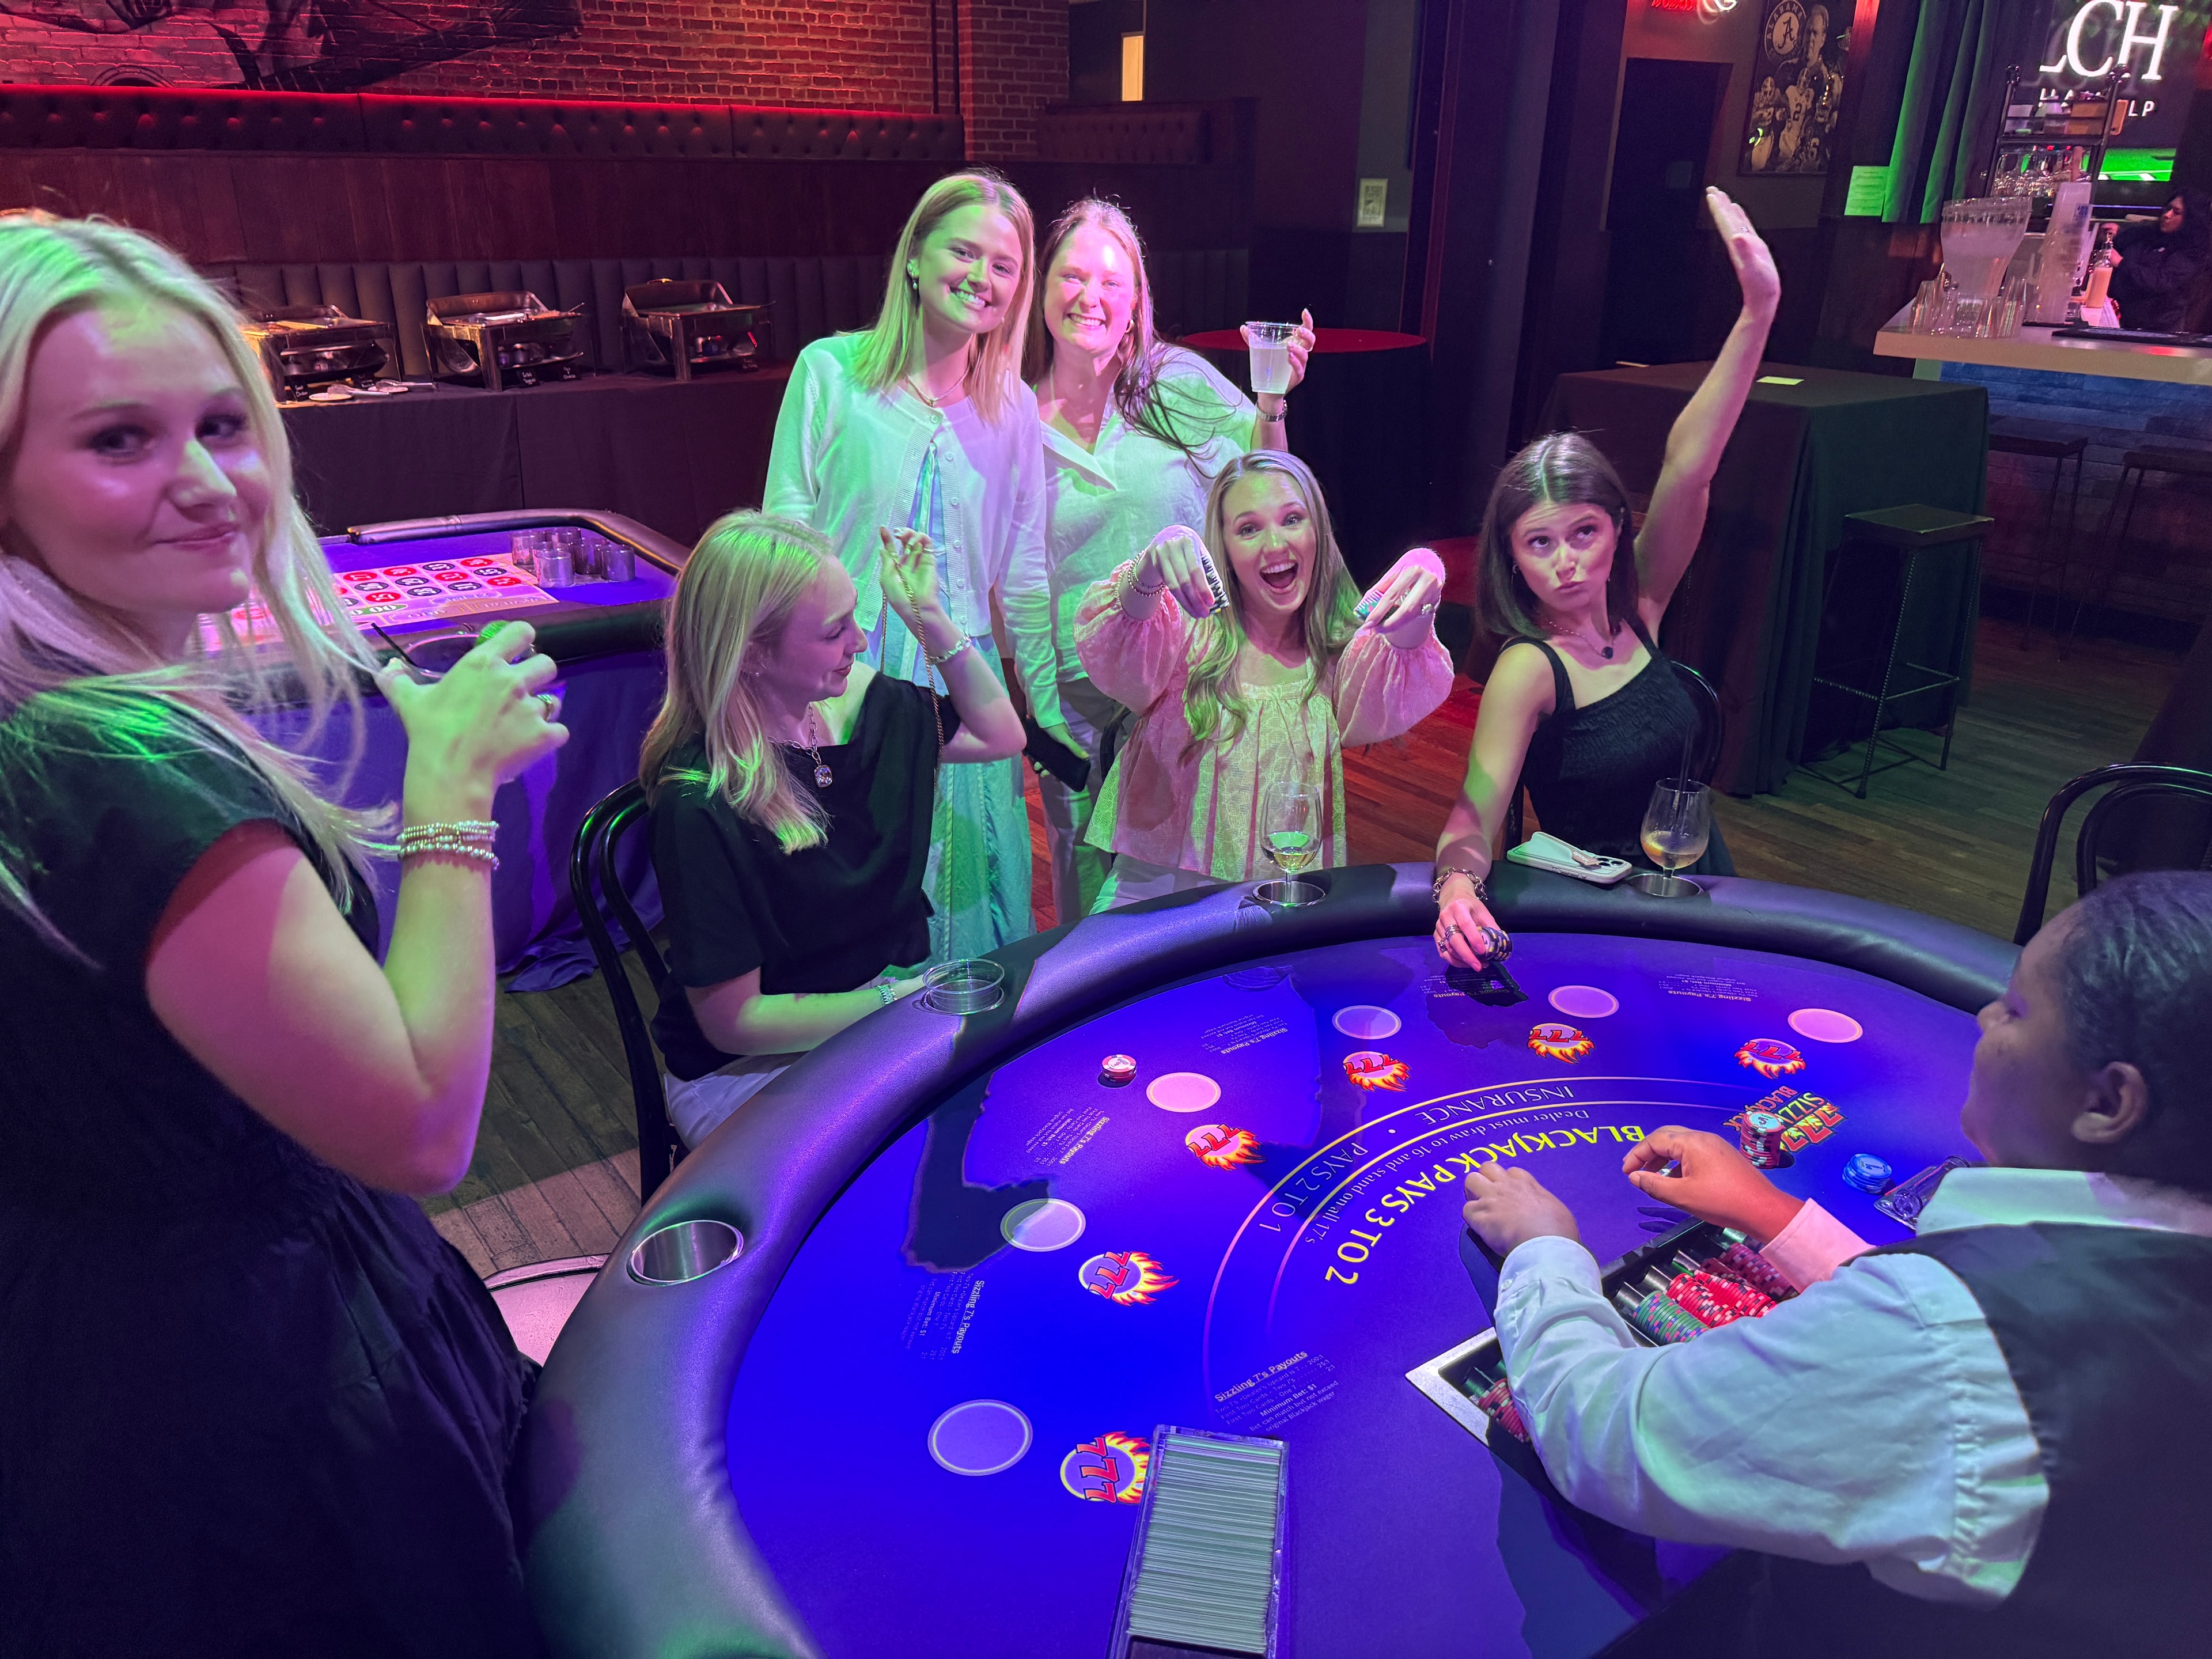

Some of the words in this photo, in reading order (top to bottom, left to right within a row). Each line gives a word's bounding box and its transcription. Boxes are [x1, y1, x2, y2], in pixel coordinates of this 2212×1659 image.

[1258, 1027, 1289, 1040] Sizzling
[1528, 1028, 1592, 1043] 777
[1218, 1040, 1250, 1055] Payouts
[1741, 1041, 1804, 1063] 777
[1343, 1053, 1400, 1076] 777
[1414, 1085, 1575, 1126] INSURANCE
[1533, 1109, 1590, 1122] Dealer
[1085, 1115, 1111, 1137] Sizzling
[1449, 1125, 1487, 1142] draw
[1488, 1116, 1530, 1131] must
[1781, 1103, 1844, 1152] 777
[1078, 1134, 1093, 1144] 7's
[1187, 1123, 1243, 1158] 777
[1430, 1137, 1450, 1147] to
[1445, 1125, 1645, 1173] BLACKJACK
[1056, 1142, 1084, 1165] Payouts
[1310, 1142, 1369, 1181] PAYS
[1384, 1152, 1412, 1173] and
[1411, 1145, 1433, 1158] 16
[1295, 1177, 1321, 1192] 2
[1353, 1168, 1387, 1195] stand
[1380, 1164, 1457, 1214] PAYS
[1271, 1192, 1309, 1218] TO
[1335, 1192, 1354, 1207] on
[1322, 1205, 1340, 1223] all
[1365, 1207, 1396, 1228] 3
[1258, 1222, 1282, 1233] 1
[1304, 1222, 1330, 1244] 17's
[1336, 1228, 1383, 1264] TO
[1089, 1251, 1132, 1299] 777
[1324, 1265, 1359, 1285] 2
[926, 1291, 941, 1316] Minimum
[964, 1279, 986, 1309] Sizzling
[921, 1317, 931, 1328] Bet:
[961, 1309, 975, 1320] 7's
[949, 1322, 971, 1354] Payouts
[1306, 1353, 1324, 1365] 200:1
[1213, 1376, 1255, 1404] Sizzling
[1251, 1369, 1270, 1383] 7's
[1267, 1348, 1309, 1376] Payouts
[1248, 1391, 1268, 1404] Cards
[1316, 1358, 1330, 1368] 25:1
[1248, 1422, 1262, 1431] Bet
[1260, 1415, 1275, 1425] can
[1272, 1403, 1295, 1418] match
[1293, 1397, 1306, 1407] but
[1305, 1392, 1317, 1401] not
[1316, 1379, 1339, 1395] exceed
[1254, 1396, 1274, 1410] Cards
[1278, 1387, 1293, 1397] One
[1259, 1395, 1294, 1417] Minimum
[1291, 1387, 1309, 1399] Bet:
[1306, 1382, 1317, 1391] $1
[1263, 1415, 1290, 1433] original
[1286, 1399, 1319, 1420] Blackjack
[1316, 1391, 1336, 1404] wager
[1076, 1437, 1119, 1504] 777
